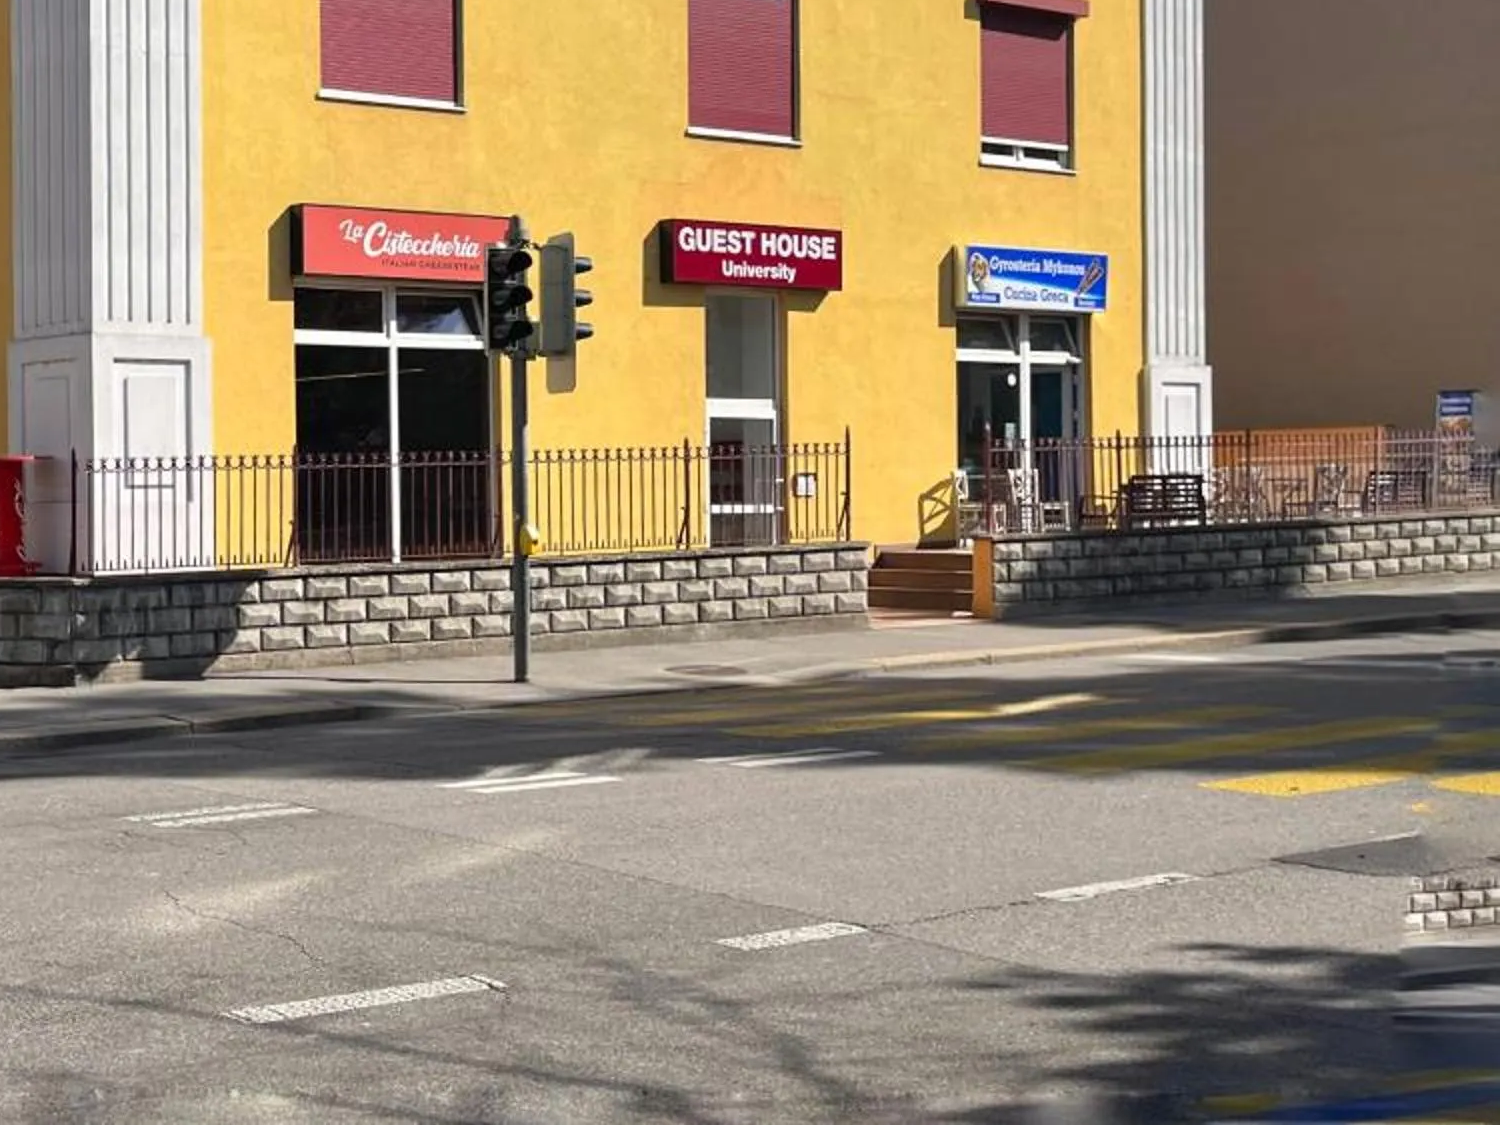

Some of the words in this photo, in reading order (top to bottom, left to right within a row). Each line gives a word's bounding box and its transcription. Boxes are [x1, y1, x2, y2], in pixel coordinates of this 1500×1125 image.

[339, 219, 364, 244] La
[363, 221, 481, 257] Cisteccheria
[678, 227, 756, 254] GUEST
[761, 233, 837, 260] HOUSE
[721, 259, 796, 283] University
[1003, 286, 1038, 302] Cucina
[1040, 288, 1069, 303] Greca
